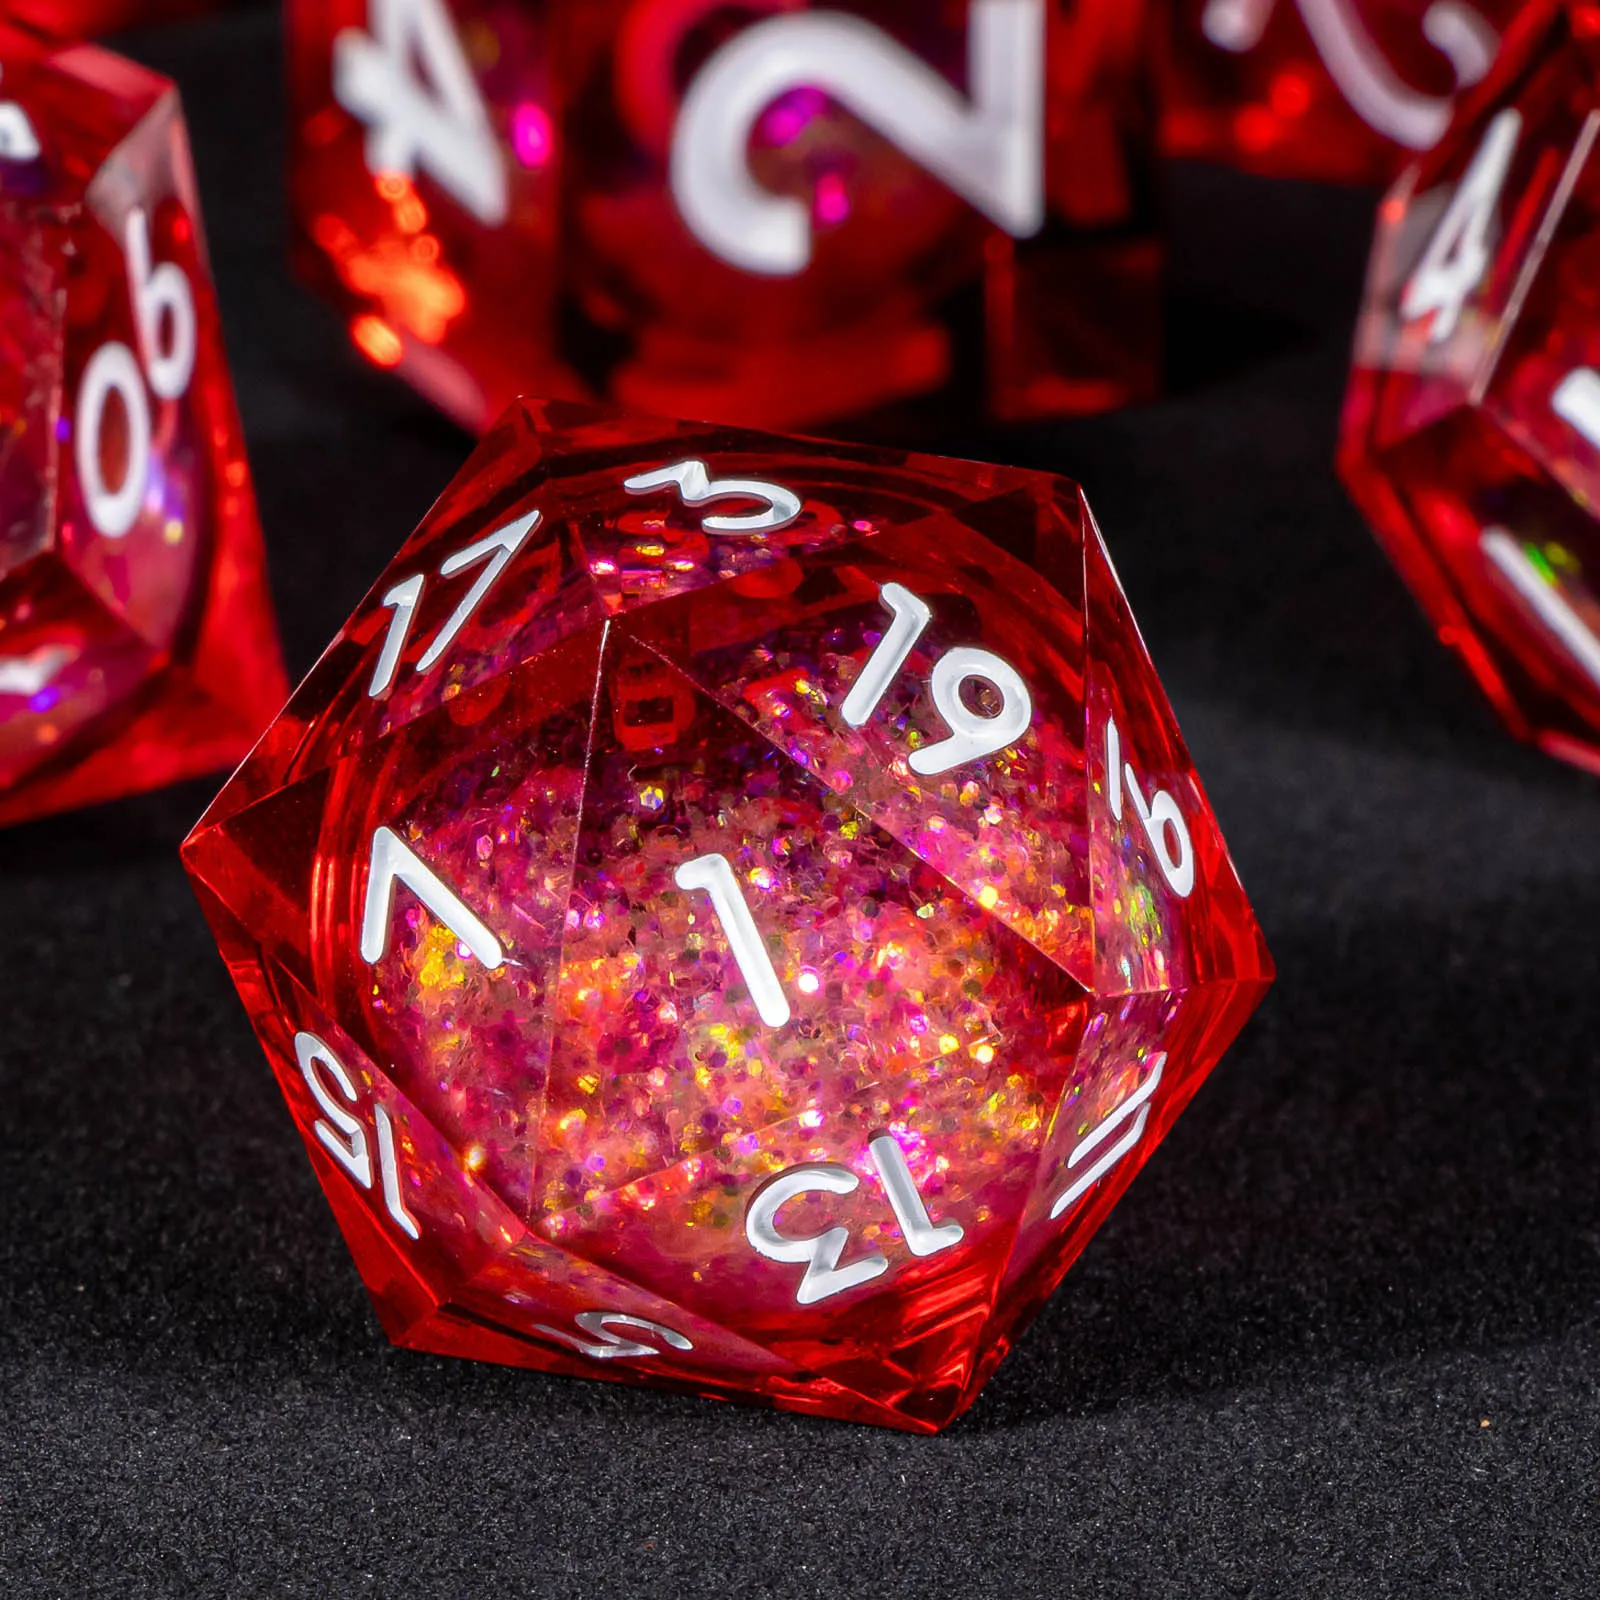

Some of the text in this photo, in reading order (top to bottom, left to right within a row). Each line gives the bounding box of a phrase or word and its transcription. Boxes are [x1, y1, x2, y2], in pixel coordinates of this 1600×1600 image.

[1403, 107, 1523, 343] 4
[623, 460, 802, 535] 3
[368, 509, 542, 700] 17
[840, 582, 1032, 776] 19
[674, 852, 790, 1028] 1
[744, 1130, 965, 1305] 13
